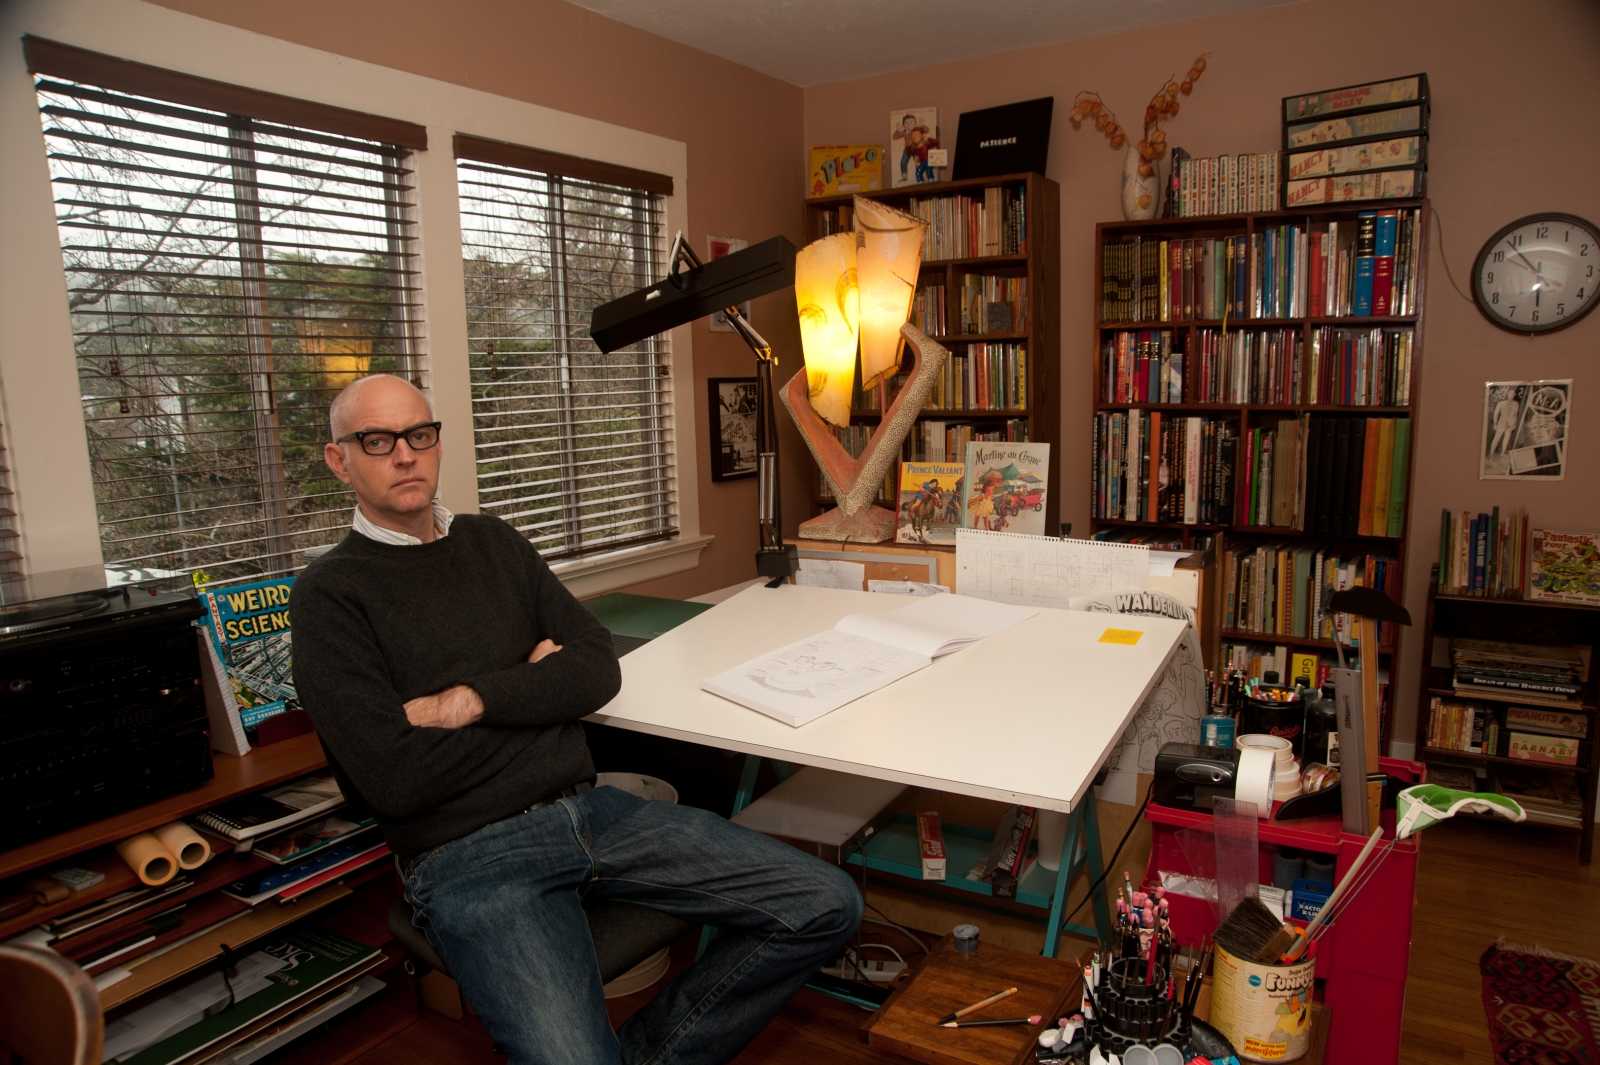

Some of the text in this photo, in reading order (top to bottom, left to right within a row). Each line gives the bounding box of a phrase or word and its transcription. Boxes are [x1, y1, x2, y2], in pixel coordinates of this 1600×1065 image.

[1536, 227, 1548, 239] 12
[1564, 230, 1569, 242] 1
[1513, 234, 1522, 248] 11
[1580, 243, 1588, 256] 2
[1493, 251, 1504, 262] 10
[1585, 265, 1593, 278] 3
[1487, 272, 1494, 284] 9
[1492, 292, 1499, 304] 8
[1576, 287, 1584, 299] 4
[1508, 305, 1516, 317] 7
[1532, 310, 1539, 321] 6
[1556, 303, 1564, 316] 5
[227, 585, 291, 613] WEIRD
[225, 611, 291, 640] SCIENC
